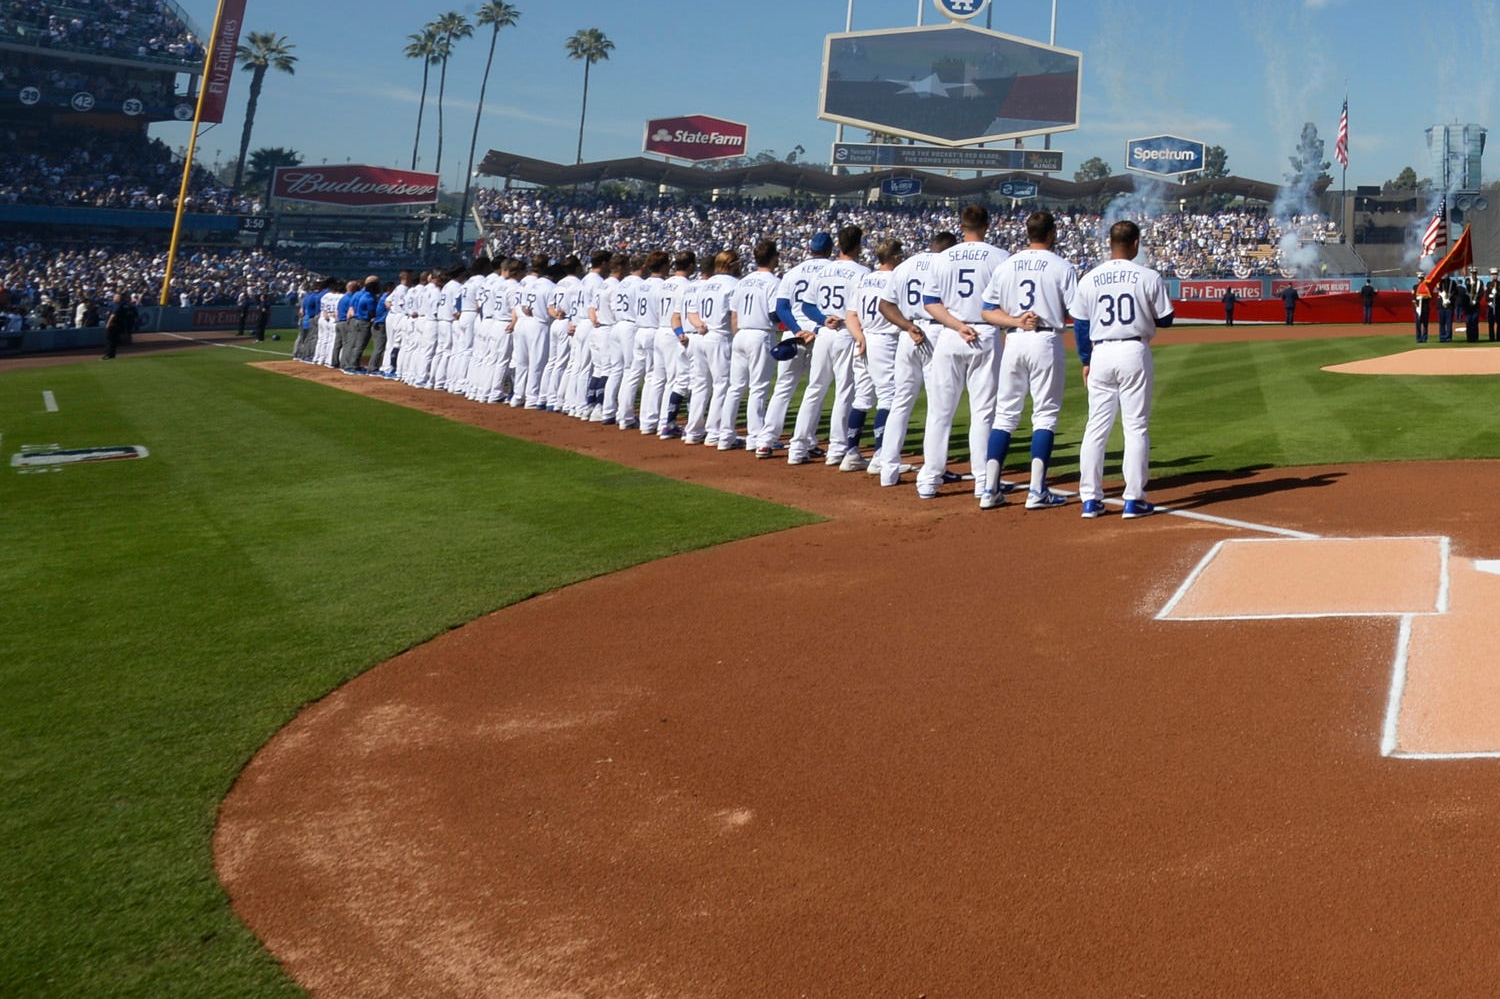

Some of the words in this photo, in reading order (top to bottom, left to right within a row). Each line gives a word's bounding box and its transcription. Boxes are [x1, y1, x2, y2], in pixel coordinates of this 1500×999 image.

[214, 19, 237, 69] Emirates
[208, 72, 229, 94] Fly
[21, 89, 38, 101] 39
[74, 95, 91, 108] 42
[124, 101, 142, 113] 53
[1133, 147, 1194, 162] Spectrum
[283, 172, 435, 196] Budweiser
[244, 219, 264, 229] 3:50
[948, 250, 989, 262] SEAGER
[1013, 259, 1048, 272] TAYLOR
[802, 264, 824, 274] KEMP
[958, 268, 975, 298] 5
[1093, 270, 1140, 288] ROBERTS
[820, 285, 845, 310] 35
[1019, 279, 1036, 311] 3
[1182, 286, 1203, 298] Fly
[637, 297, 647, 316] 18
[661, 297, 672, 317] 17
[701, 297, 714, 319] 10
[744, 293, 754, 315] 11
[862, 295, 879, 320] 14
[1098, 293, 1136, 327] 30
